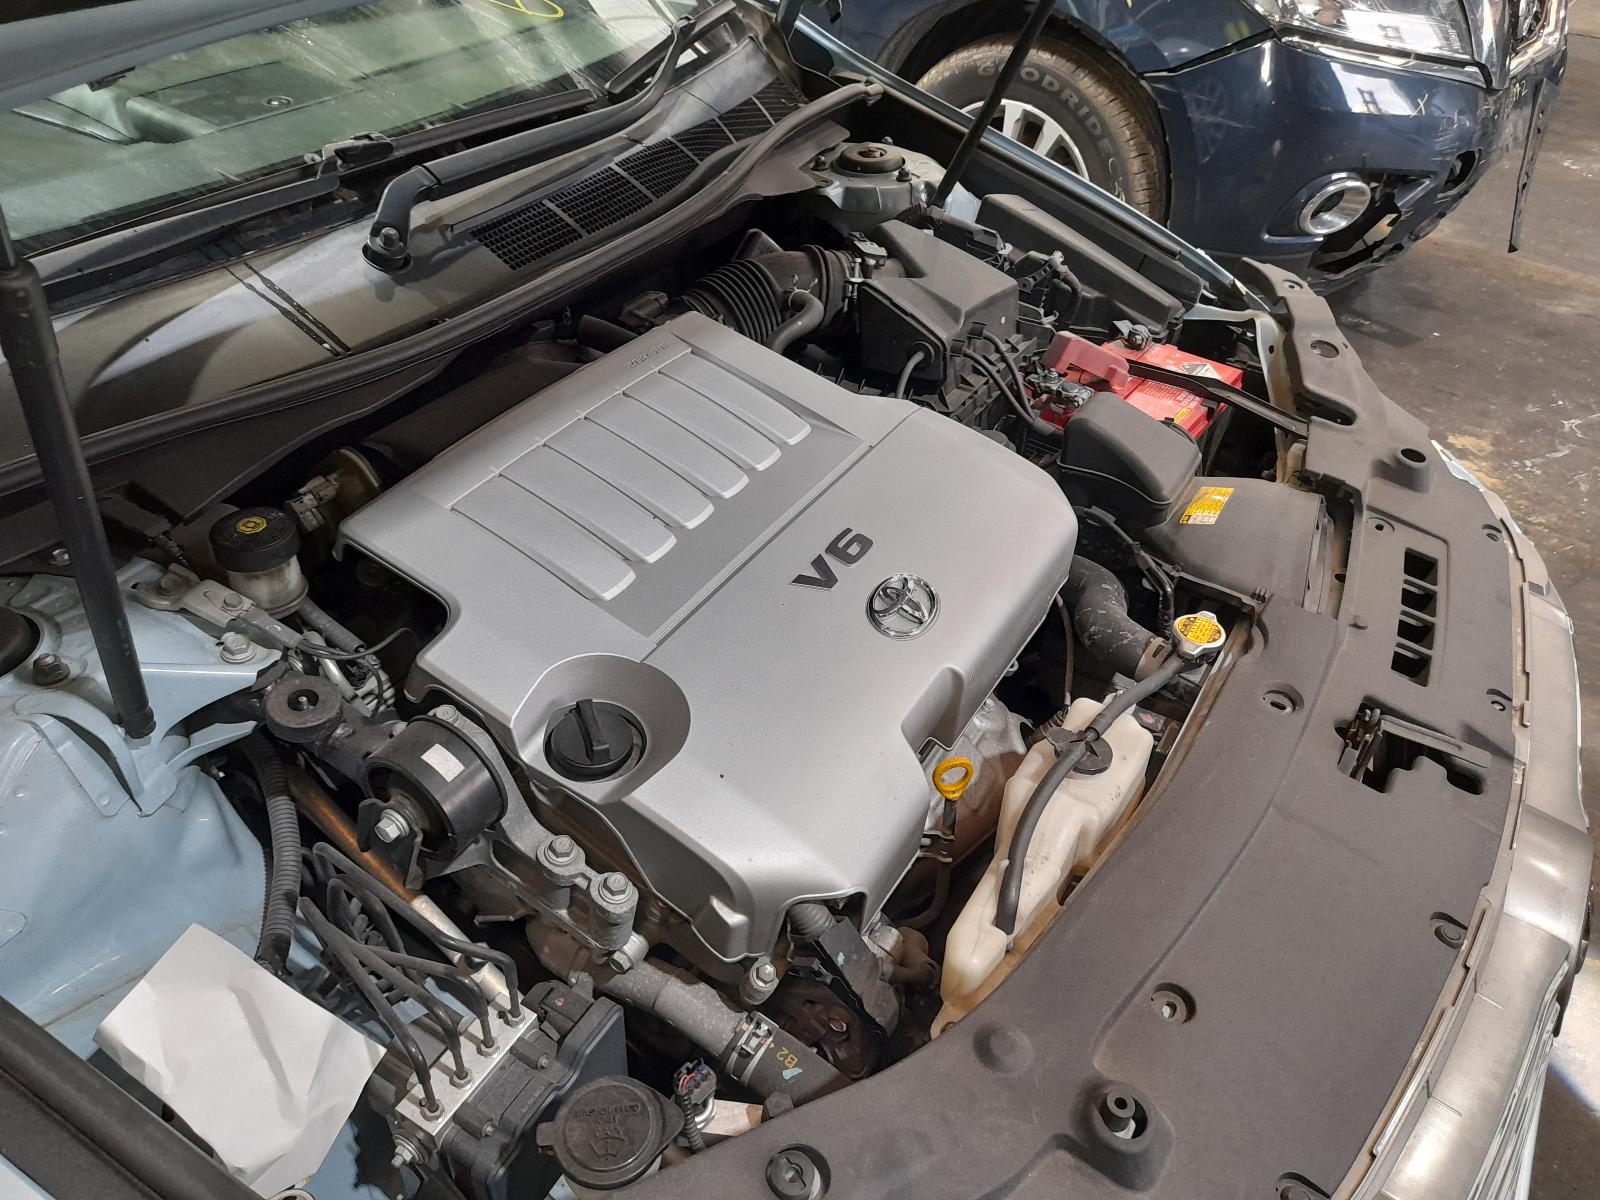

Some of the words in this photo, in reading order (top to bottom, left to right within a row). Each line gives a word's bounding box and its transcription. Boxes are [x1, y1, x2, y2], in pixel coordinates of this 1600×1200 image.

[977, 62, 1117, 158] GODRIDE
[789, 527, 874, 590] V6
[776, 1046, 799, 1069] B2
